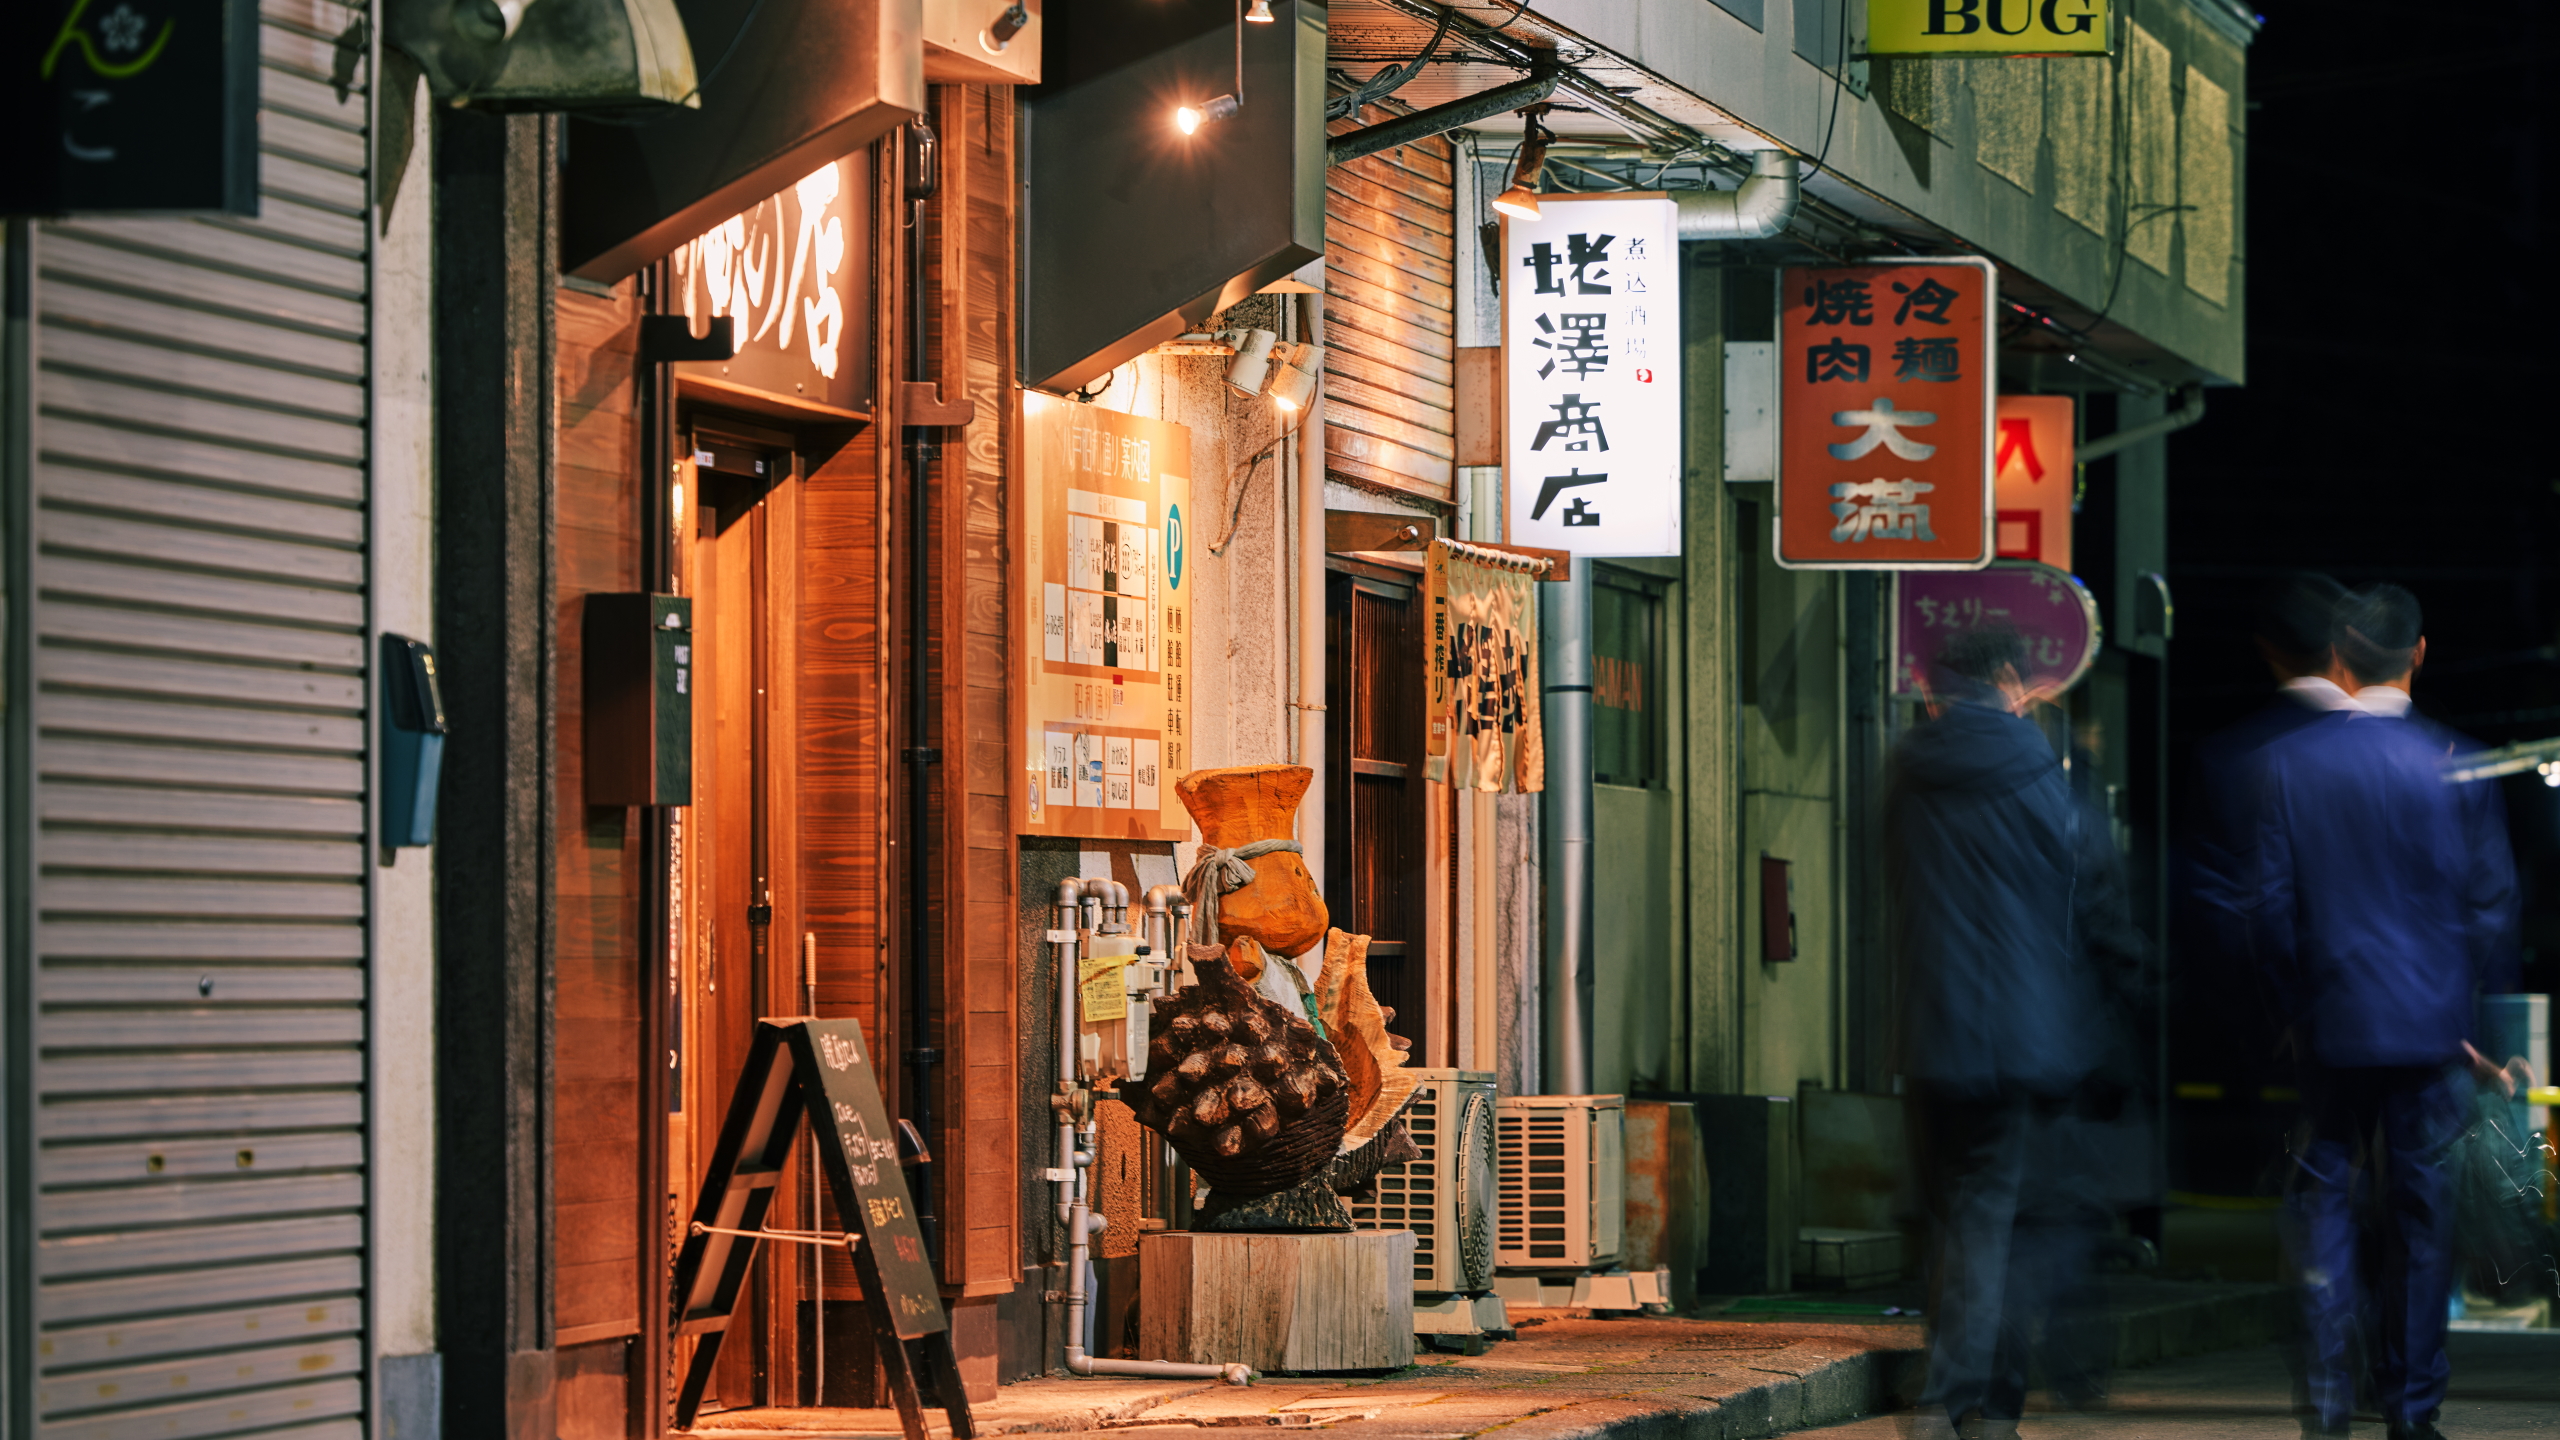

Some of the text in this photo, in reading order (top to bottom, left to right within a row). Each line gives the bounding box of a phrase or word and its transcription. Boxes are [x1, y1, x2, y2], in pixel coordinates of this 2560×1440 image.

[1921, 0, 2098, 35] BUG
[1624, 238, 1647, 359] 煮込酒場
[1804, 277, 1873, 383] 焼肉
[1891, 277, 1961, 383] 冷麺
[1522, 233, 1616, 527] 蛯澤商店
[1828, 397, 1937, 543] 大満
[1592, 654, 1642, 712] AMAN
